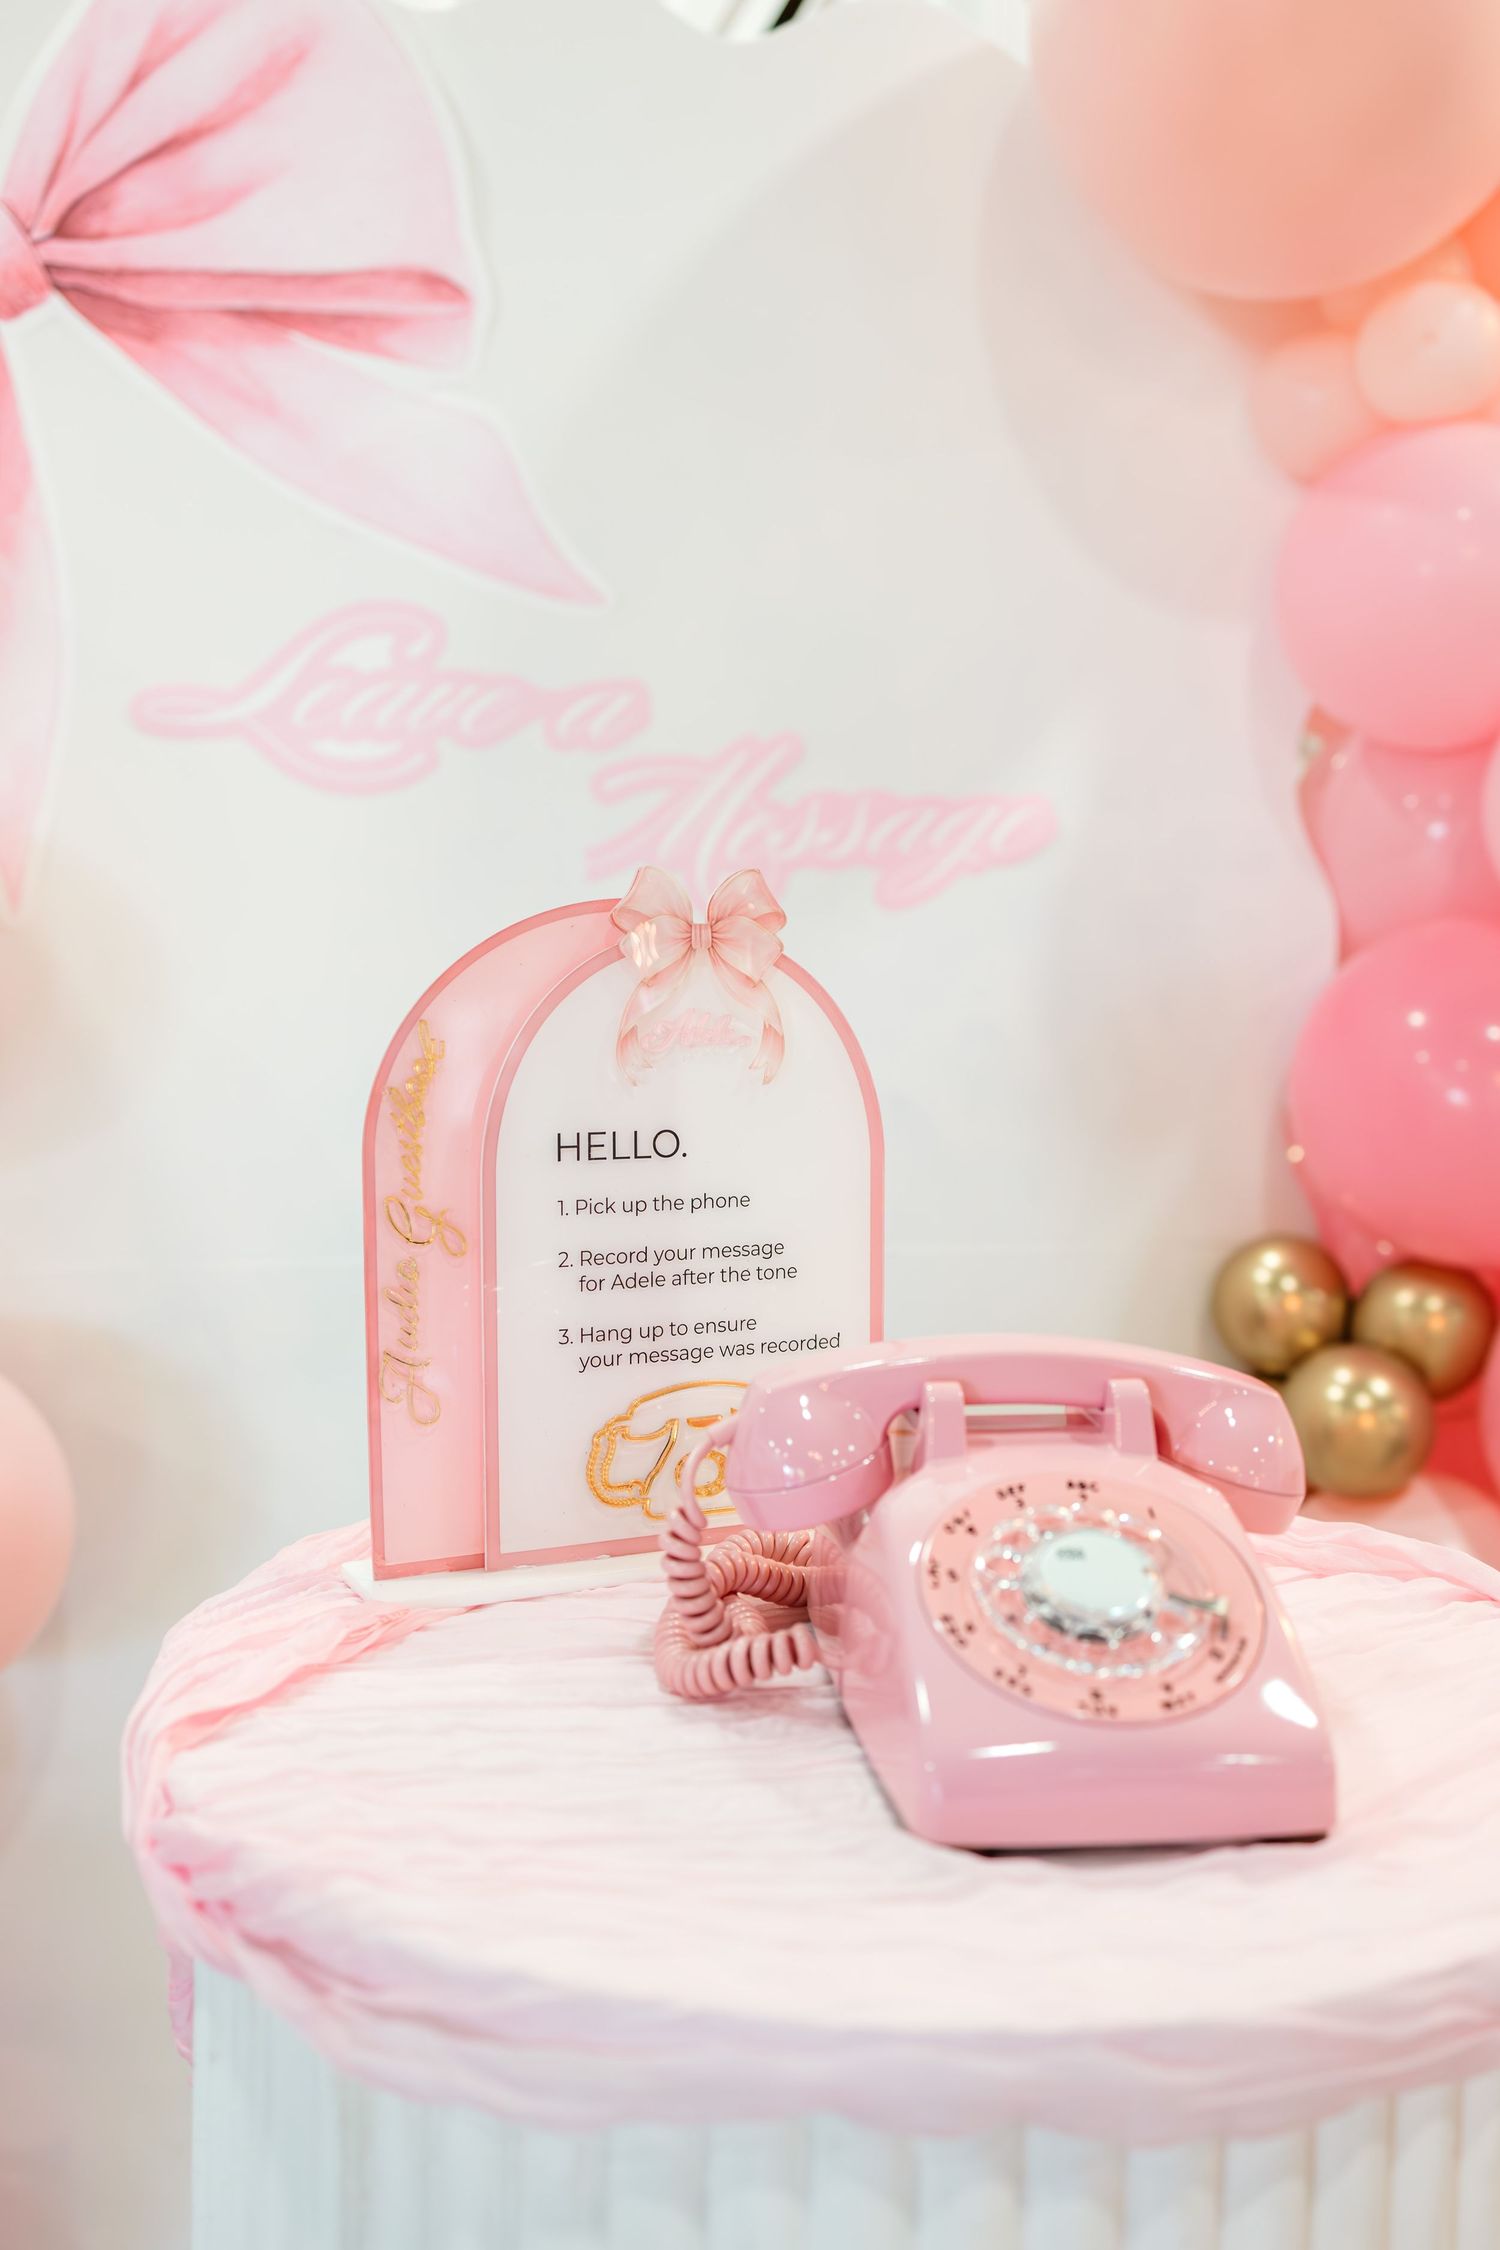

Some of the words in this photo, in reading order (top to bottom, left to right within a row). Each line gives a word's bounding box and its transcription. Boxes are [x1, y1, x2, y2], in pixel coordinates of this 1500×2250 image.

[130, 602, 526, 793] Leave
[540, 678, 653, 750] a
[588, 735, 1058, 908] Message
[383, 1019, 467, 1257] Guestbook
[557, 1129, 687, 1162] HELLO.
[557, 1200, 569, 1216] 1.
[575, 1197, 616, 1215] Pick
[622, 1199, 647, 1217] up
[652, 1195, 685, 1212] the
[690, 1193, 751, 1214] phone
[558, 1251, 574, 1268] 2.
[580, 1246, 648, 1267] Record
[653, 1247, 696, 1266] your
[702, 1242, 785, 1258] message
[579, 1275, 605, 1292] for
[611, 1271, 666, 1291] Adele
[671, 1269, 715, 1287] after
[720, 1266, 751, 1284] the
[756, 1265, 798, 1281] tone
[379, 1256, 441, 1425] Audio
[558, 1328, 574, 1345] 3.
[580, 1326, 632, 1345] Hang
[639, 1325, 664, 1342] up
[669, 1321, 689, 1337] to
[693, 1318, 758, 1335] ensure
[578, 1352, 623, 1374] your
[629, 1346, 715, 1364] message
[719, 1342, 756, 1358] was
[760, 1332, 841, 1355] recorded
